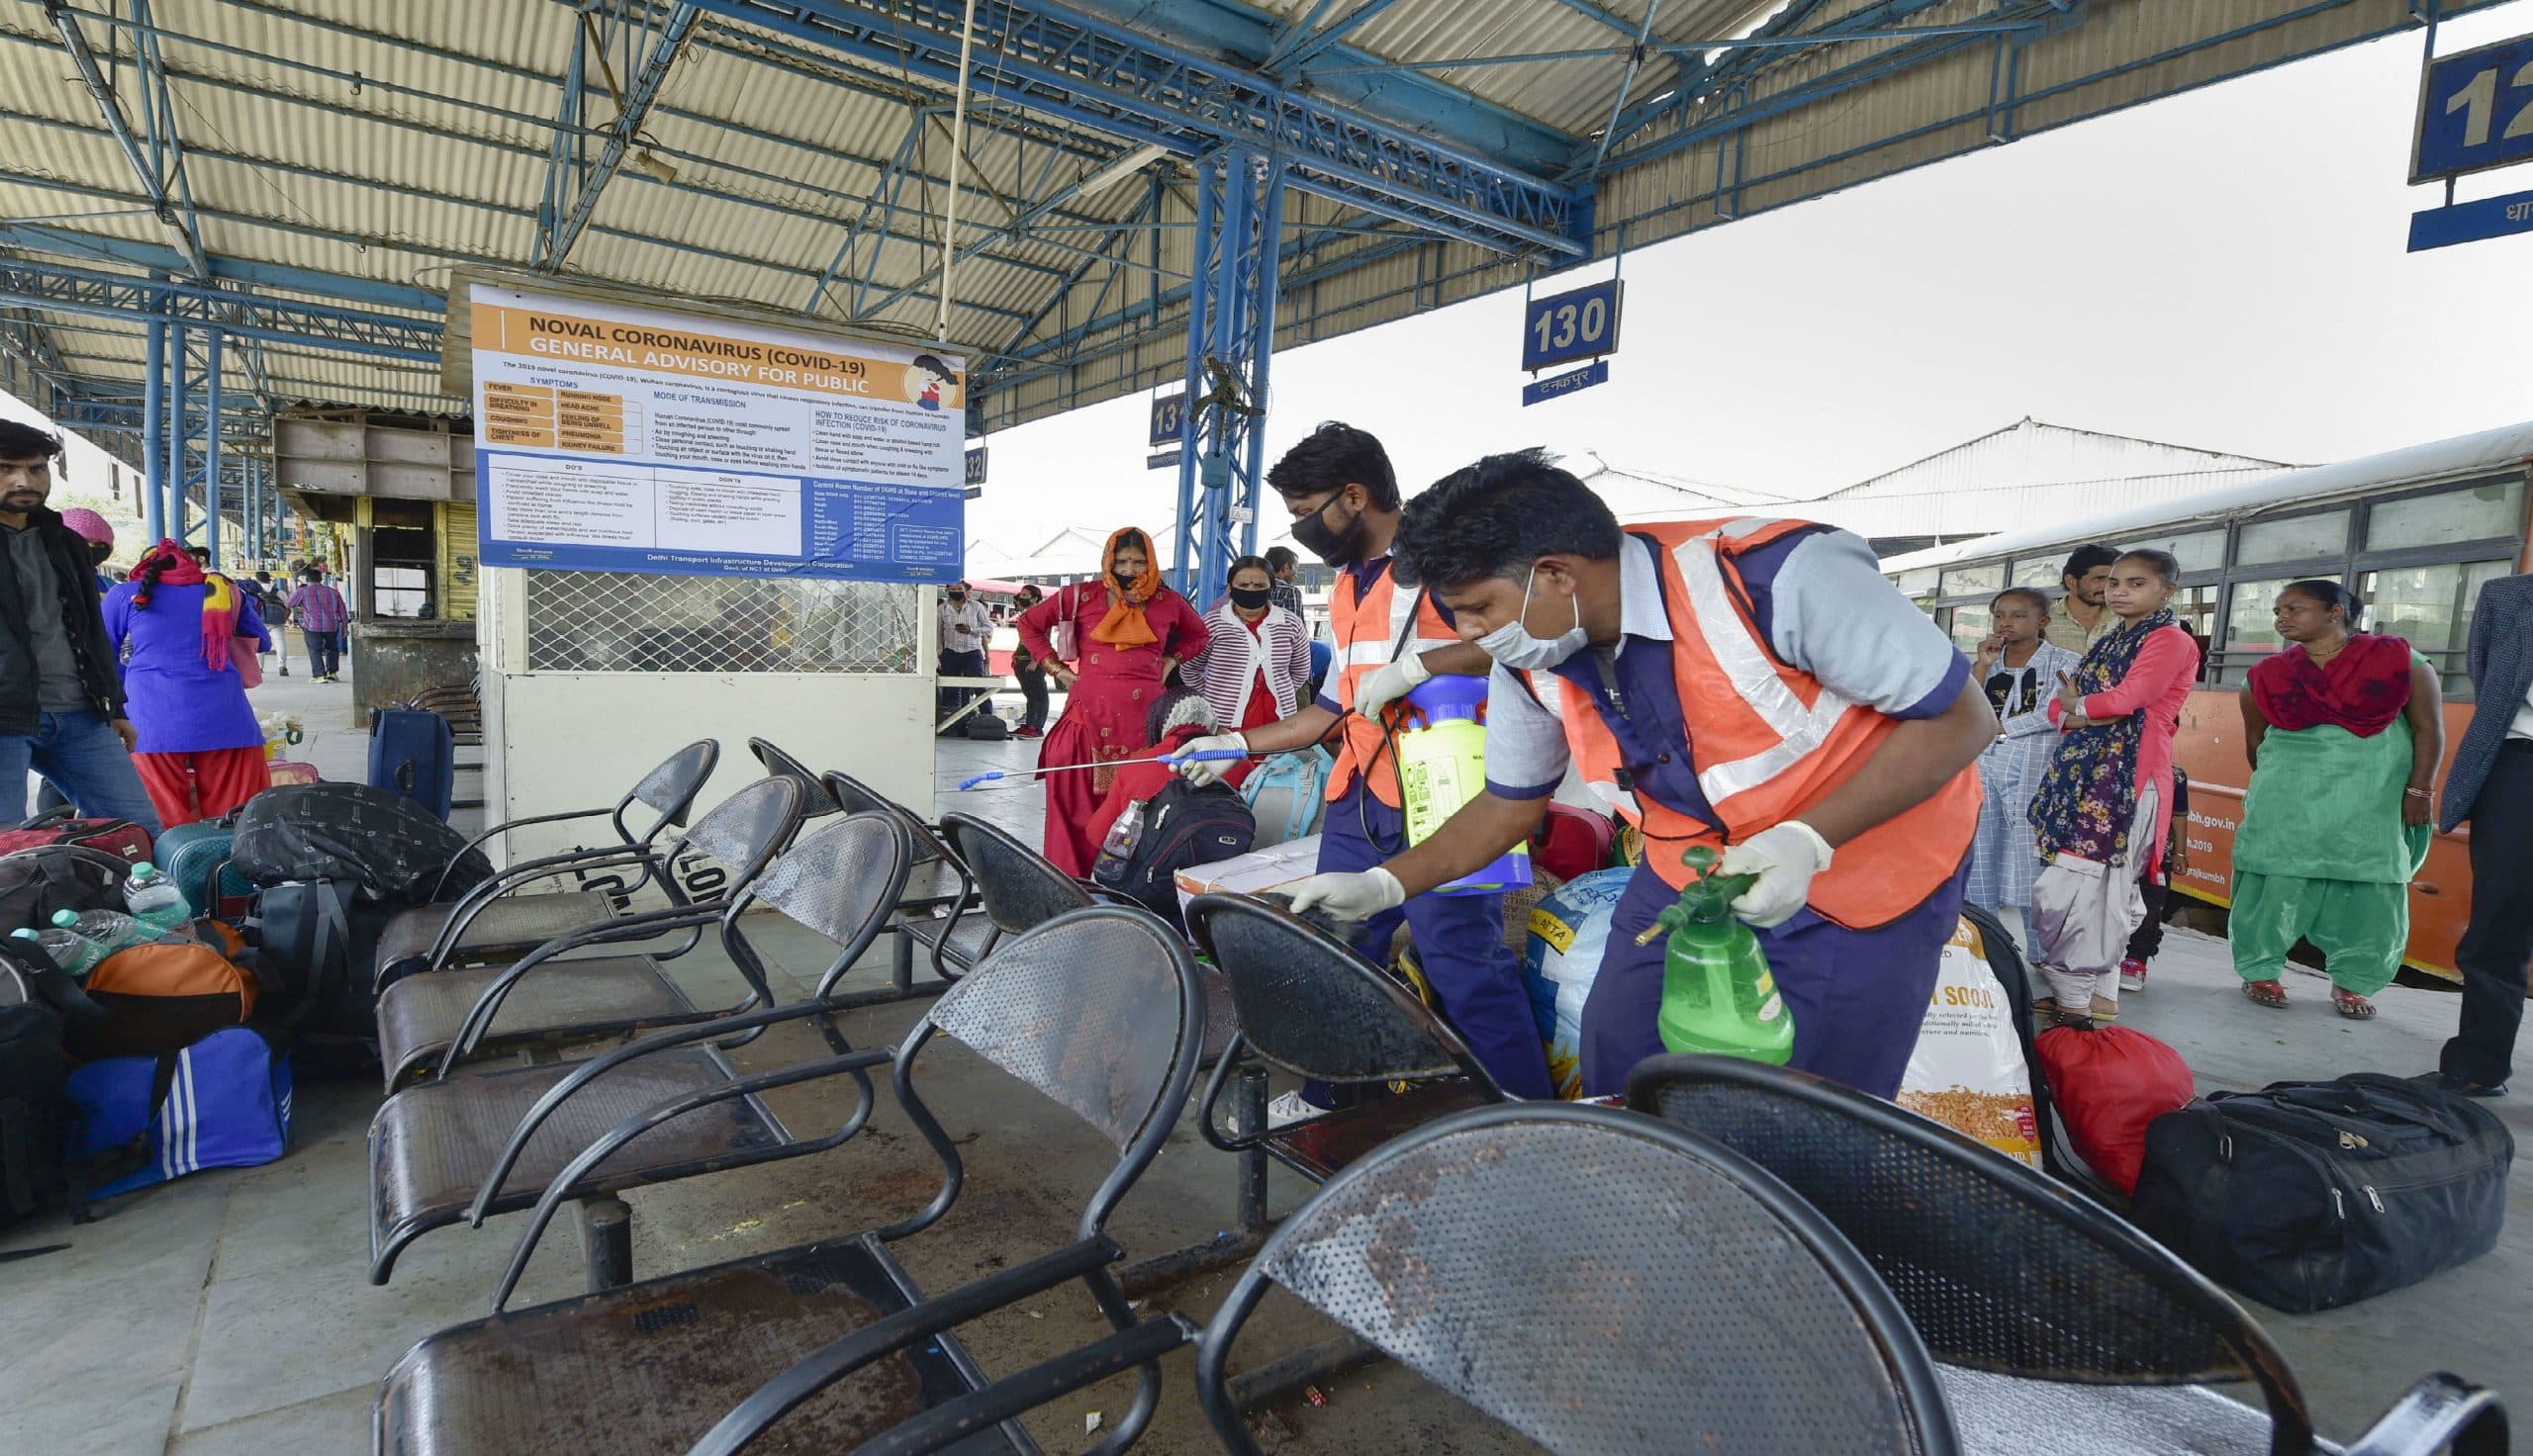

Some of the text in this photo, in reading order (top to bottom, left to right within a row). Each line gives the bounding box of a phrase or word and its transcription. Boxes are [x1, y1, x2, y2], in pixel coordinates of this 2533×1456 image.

[1535, 297, 1606, 353] 130
[529, 317, 865, 377] NOVAL CORONAVIRUS (COVID-19)
[518, 363, 535, 372] 2019
[537, 365, 556, 374] novel
[558, 367, 598, 379] coronavirus
[529, 335, 869, 393] GENERAL ADVISORY FOR PUBLIC
[529, 376, 578, 389] SYMPTOMS
[489, 397, 528, 406] DIFFICULTY
[653, 391, 676, 401] MODE
[690, 395, 745, 409] TRANSMISSION
[490, 414, 527, 423] COUGHING
[815, 418, 887, 433] INFECTION (COVID-19)
[844, 413, 872, 423] REDUCE
[874, 416, 888, 425] RISK
[901, 420, 946, 431] CORONAVIRUS
[1156, 404, 1185, 435] 13
[562, 430, 601, 439] PNEUMONIA
[647, 553, 667, 562] Delhi
[670, 554, 707, 564] Transport
[710, 556, 761, 566] Infrastructure
[811, 561, 853, 570] Corporation
[2187, 810, 2235, 831] bh.gov.in
[1540, 919, 1566, 941] ATTA
[1944, 985, 1996, 1009] SOOJI
